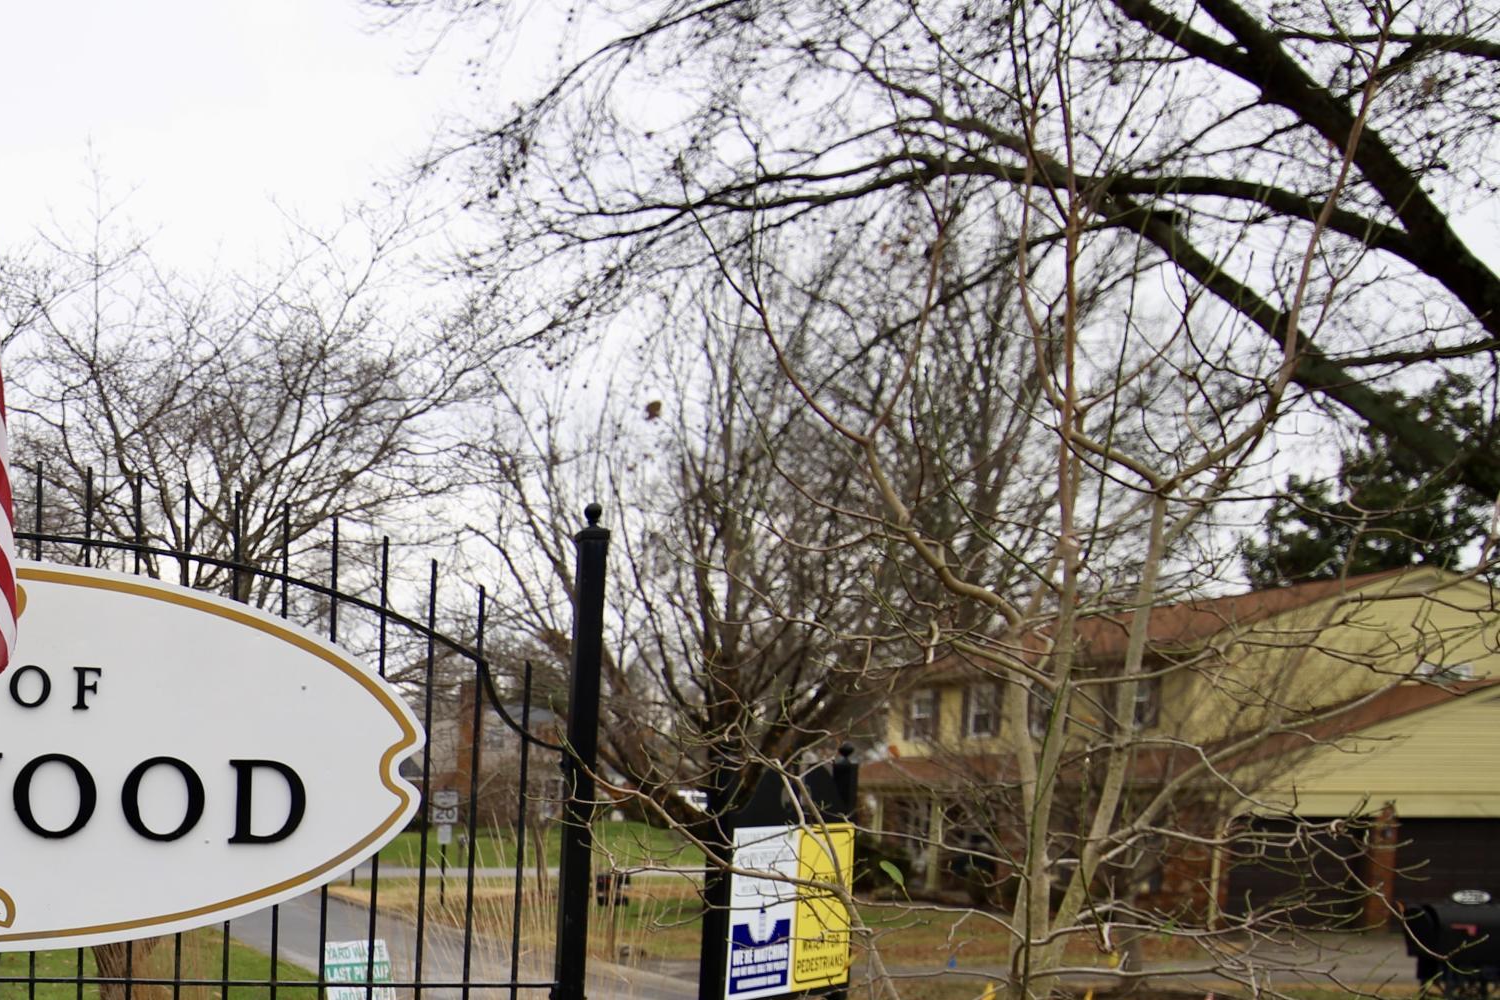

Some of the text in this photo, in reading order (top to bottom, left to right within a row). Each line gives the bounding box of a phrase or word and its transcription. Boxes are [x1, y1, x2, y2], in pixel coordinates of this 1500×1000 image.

[9, 664, 102, 710] OF
[326, 944, 384, 960] YARD WATE
[797, 954, 844, 974] PEDESTRIANS
[326, 966, 352, 982] LAST
